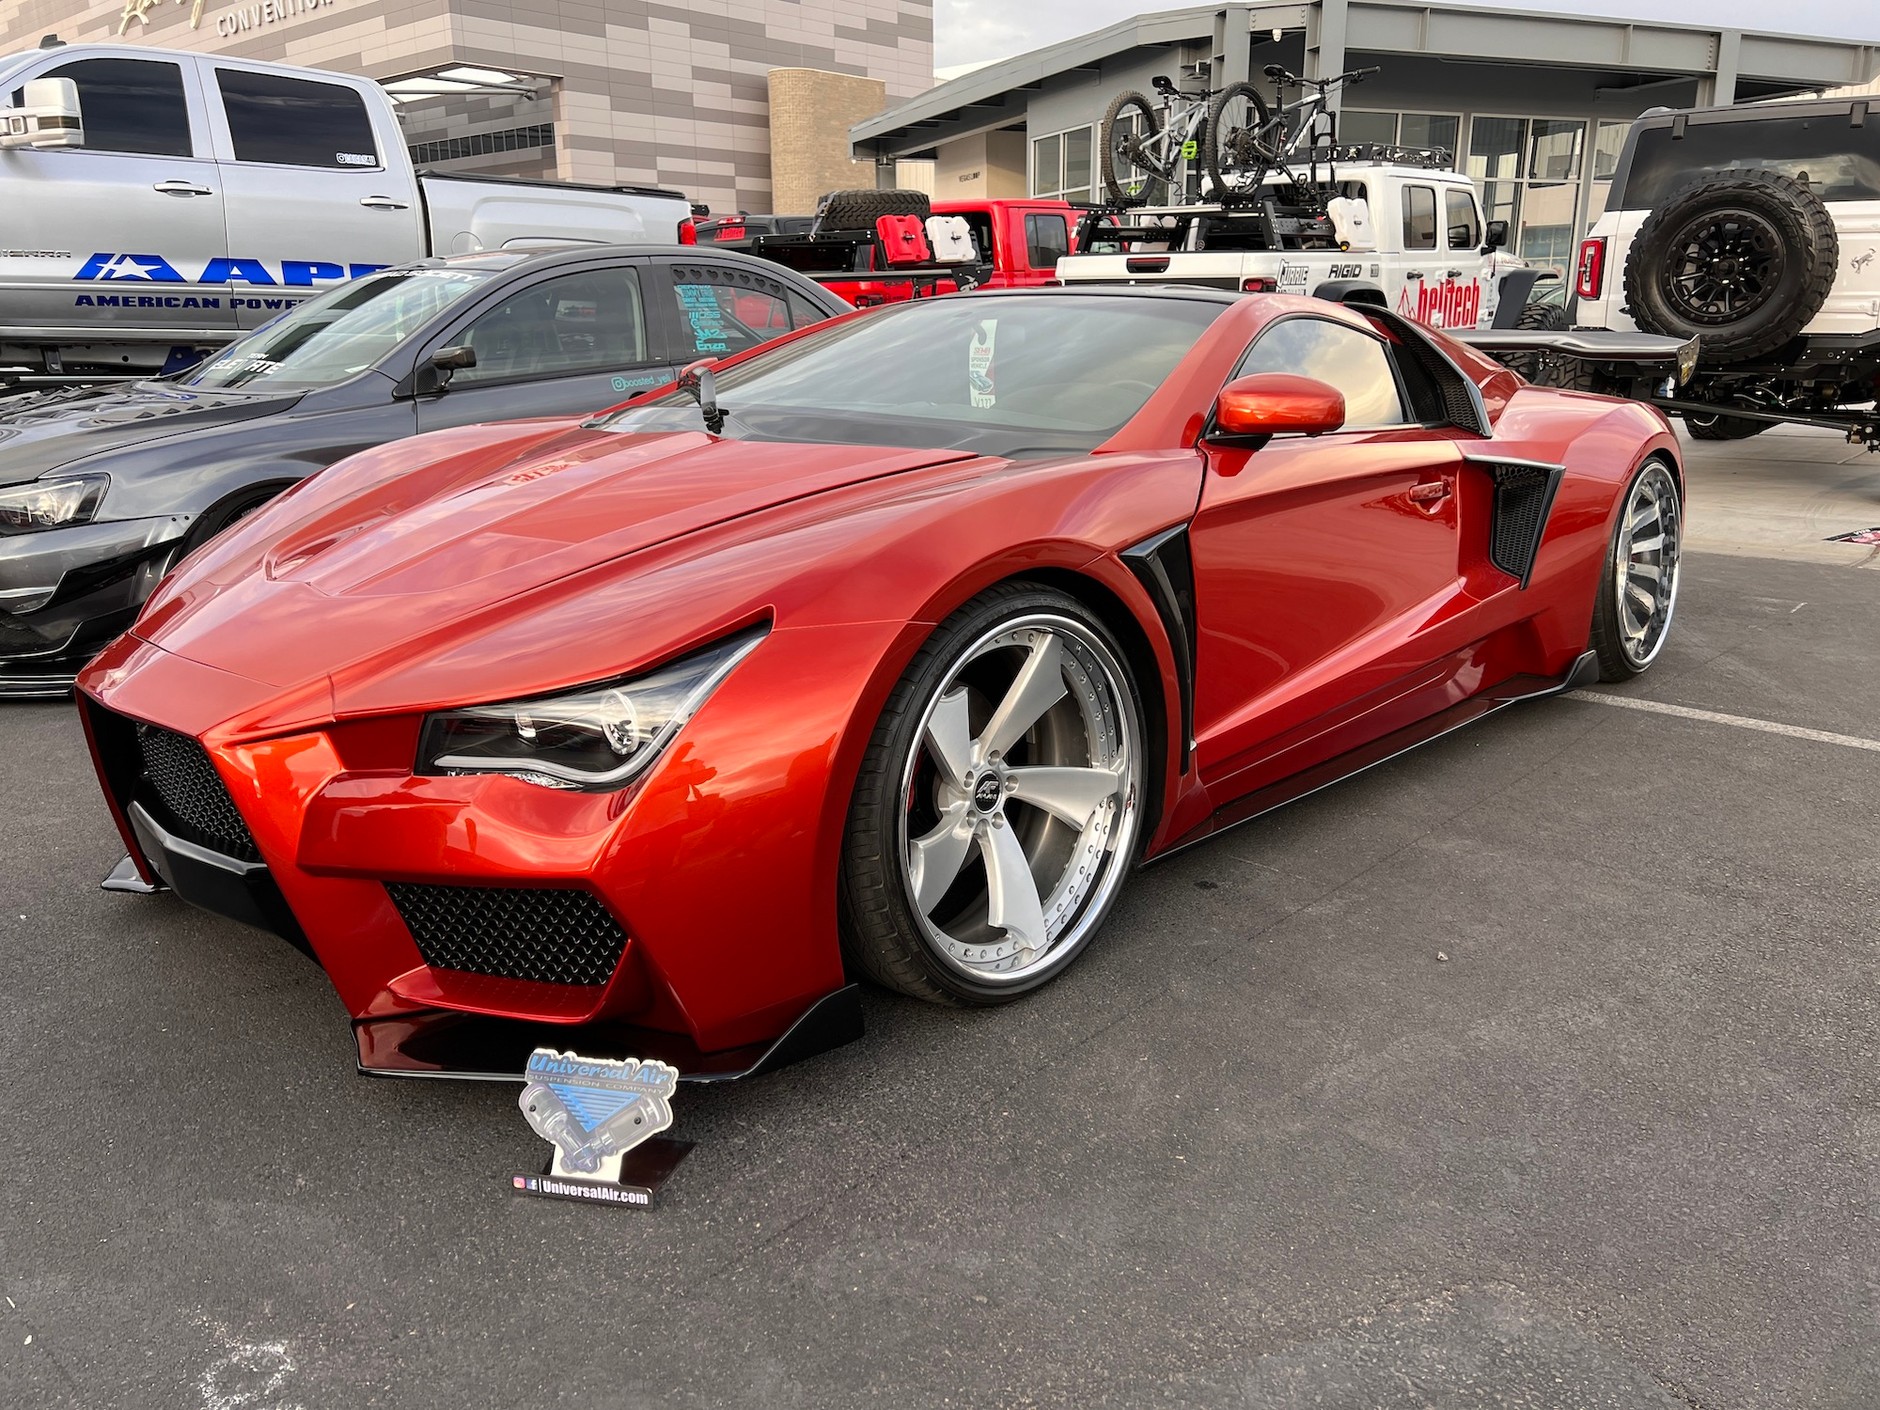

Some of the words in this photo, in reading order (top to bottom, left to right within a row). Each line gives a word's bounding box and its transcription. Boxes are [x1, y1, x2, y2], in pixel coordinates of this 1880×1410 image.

[216, 0, 334, 37] CONVENTI
[0, 249, 72, 259] IERRA
[1277, 259, 1309, 288] CURRIE
[1328, 264, 1362, 279] RIGID
[74, 294, 221, 309] AMERICAN
[229, 298, 306, 310] POWE
[1417, 277, 1479, 328] helitech
[529, 1055, 630, 1080] Universal
[632, 1066, 669, 1085] Air
[527, 1074, 600, 1088] SUSPENSION
[605, 1083, 665, 1094] COMPANY
[543, 1180, 648, 1204] UniversalAir.com
